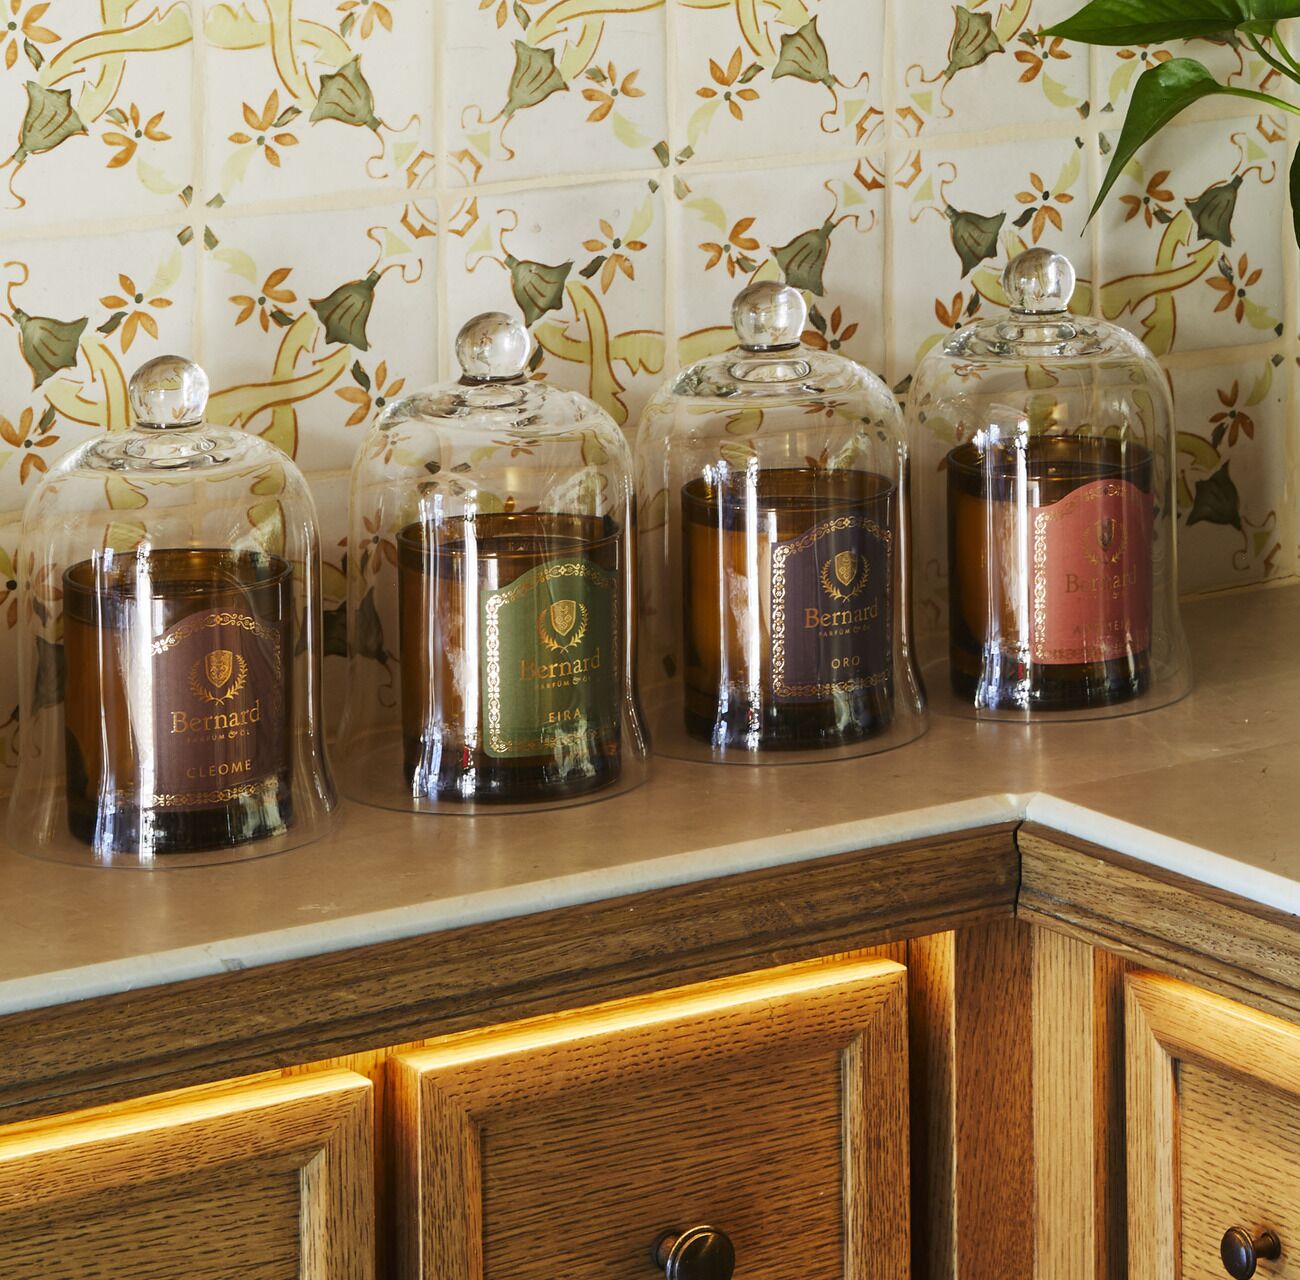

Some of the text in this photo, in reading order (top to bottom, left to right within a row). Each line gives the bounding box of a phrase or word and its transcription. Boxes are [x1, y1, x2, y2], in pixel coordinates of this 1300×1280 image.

[804, 596, 878, 629] Bernard
[519, 647, 600, 681] Bernard
[831, 656, 860, 669] ORO
[170, 699, 260, 734] Bernard
[548, 707, 582, 723] EIRA
[186, 759, 252, 779] CLEOME
